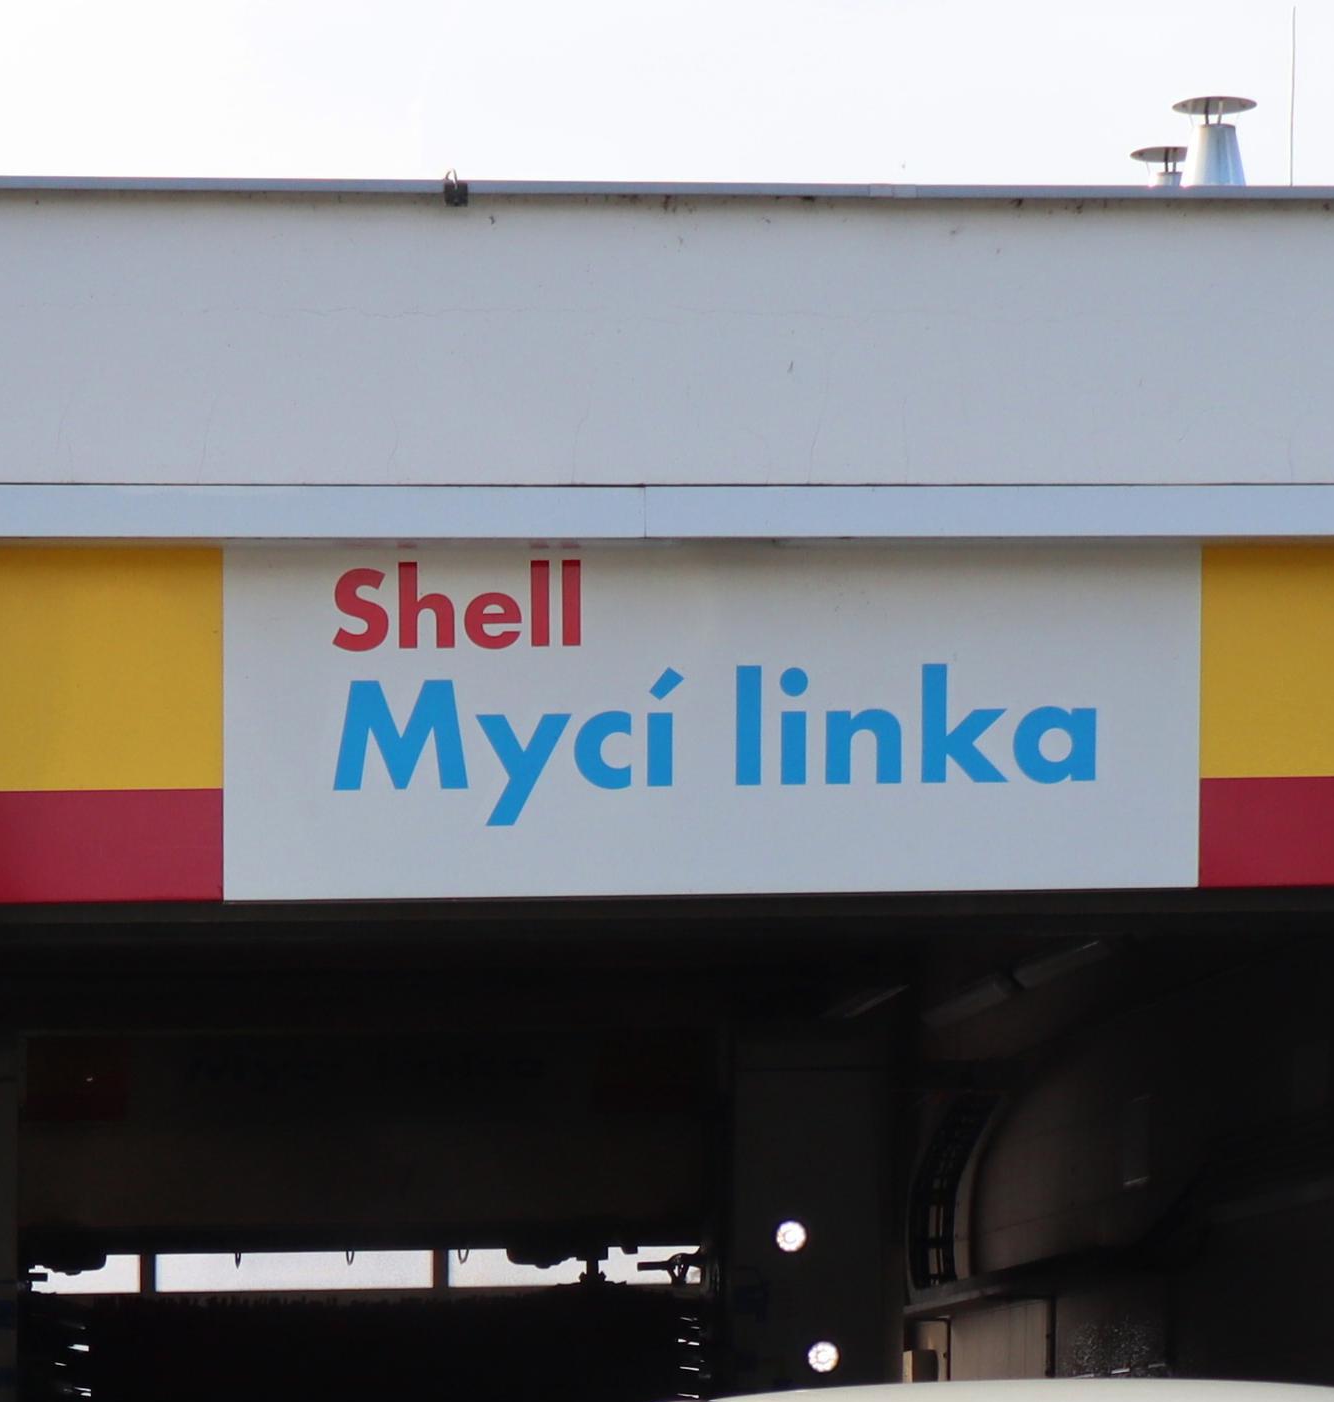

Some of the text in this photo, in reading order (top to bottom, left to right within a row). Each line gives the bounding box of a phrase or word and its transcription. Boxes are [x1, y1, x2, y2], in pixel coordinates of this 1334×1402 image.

[332, 559, 581, 652] Shell
[333, 663, 1098, 827] Mycí linka
